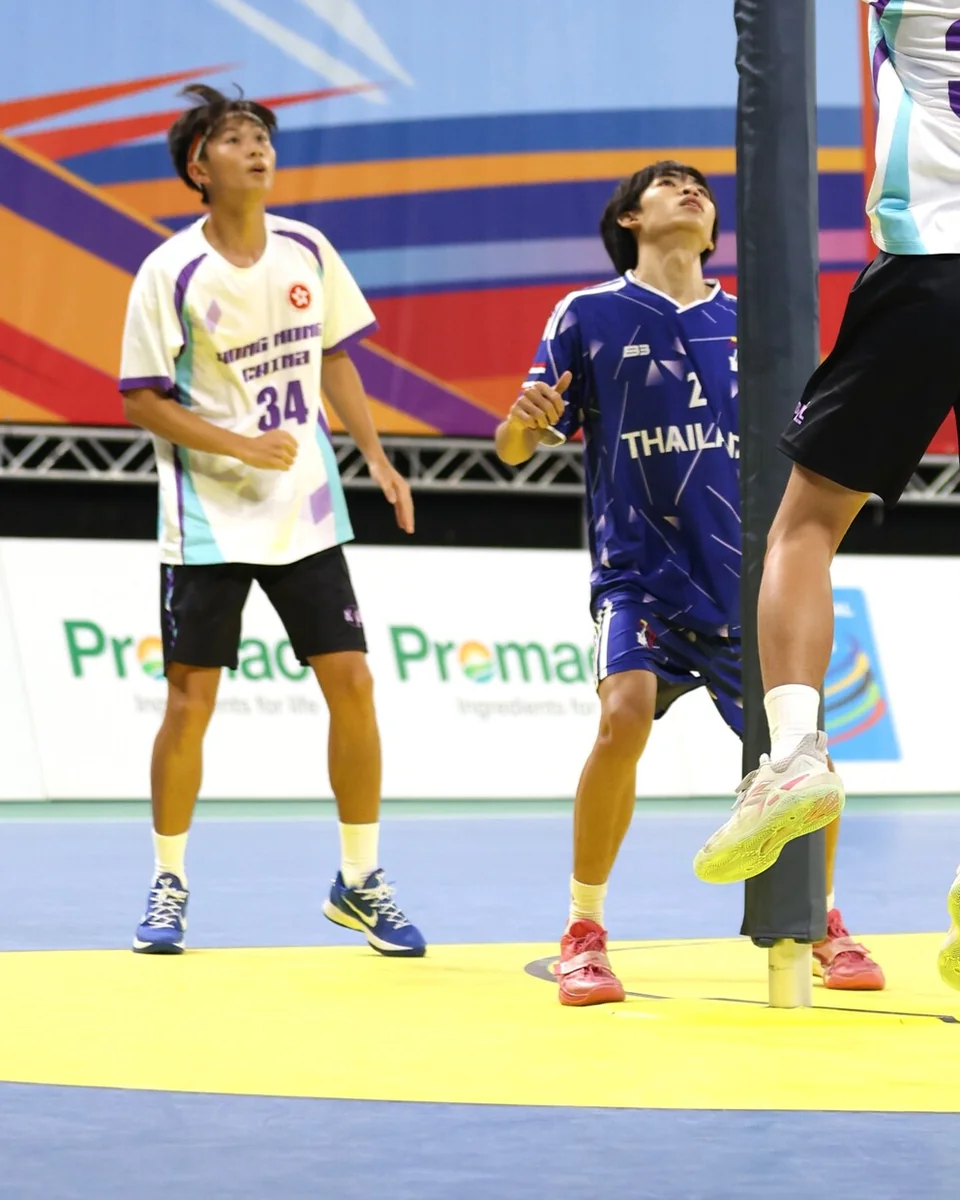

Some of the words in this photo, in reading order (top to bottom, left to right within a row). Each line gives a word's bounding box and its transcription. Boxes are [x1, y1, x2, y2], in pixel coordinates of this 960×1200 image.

[256, 379, 309, 432] 34
[687, 371, 708, 409] 2
[63, 619, 312, 681] Proac
[389, 624, 597, 683] Proma
